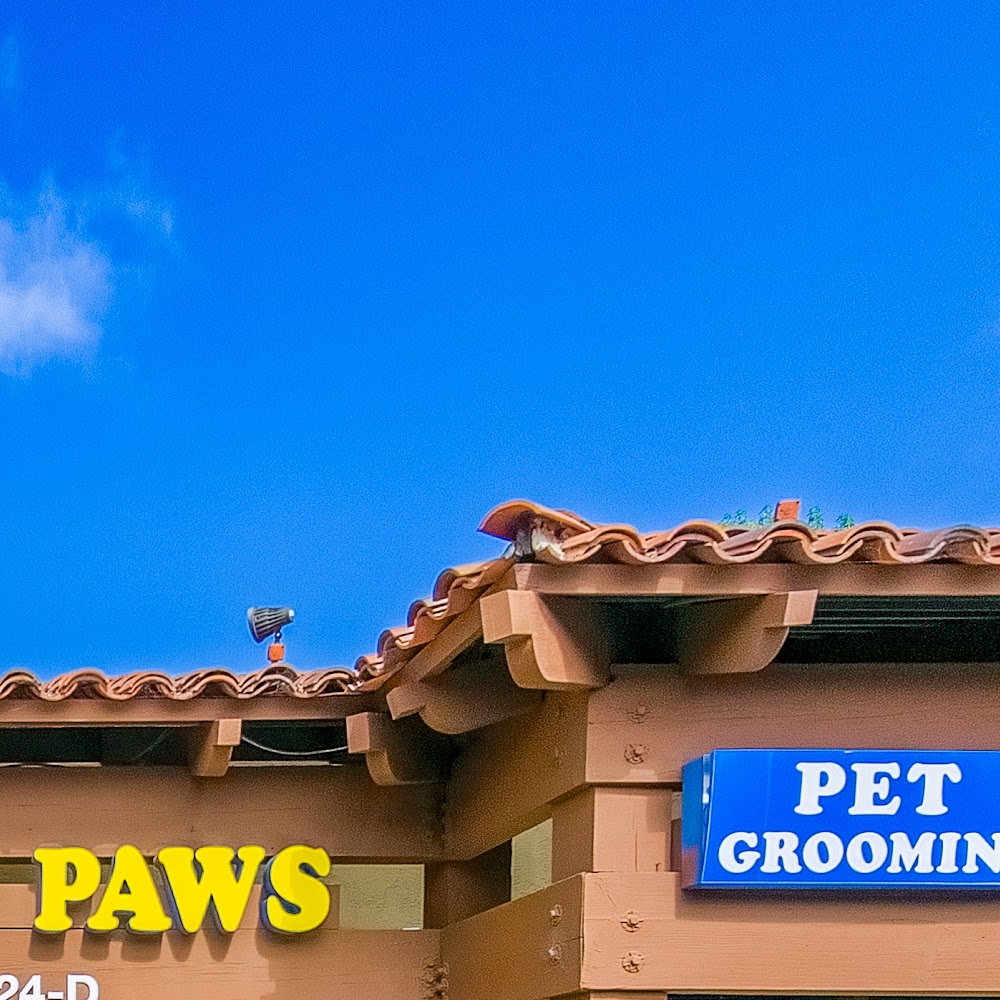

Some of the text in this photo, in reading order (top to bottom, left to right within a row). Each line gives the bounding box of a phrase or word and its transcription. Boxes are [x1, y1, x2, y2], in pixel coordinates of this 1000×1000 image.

[794, 761, 962, 815] PET
[718, 832, 1000, 873] GROOMIN
[33, 844, 331, 933] PAWS
